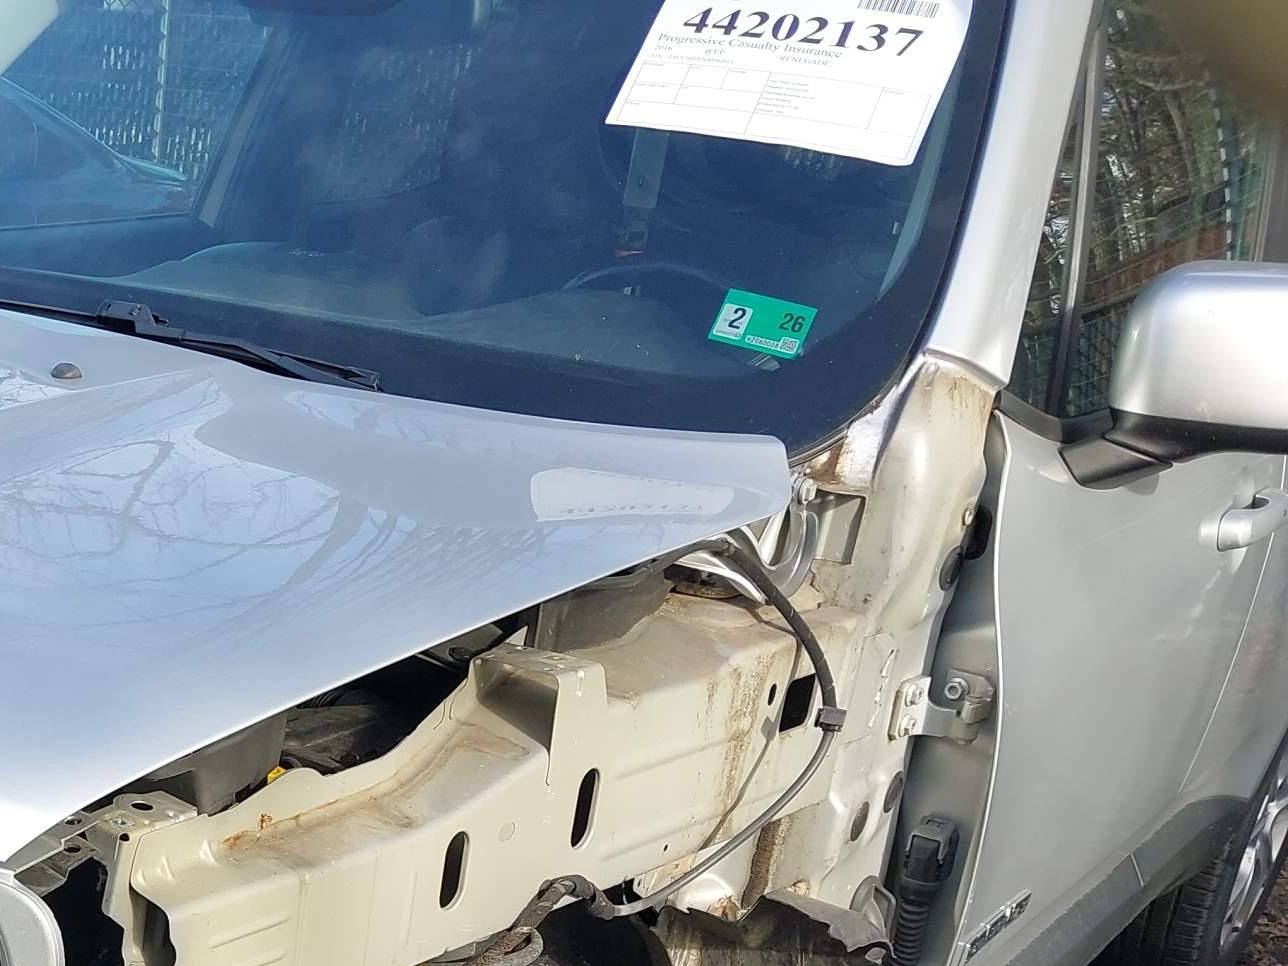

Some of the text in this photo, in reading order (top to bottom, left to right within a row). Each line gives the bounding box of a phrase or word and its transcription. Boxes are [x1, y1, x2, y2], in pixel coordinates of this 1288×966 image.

[682, 7, 925, 56] 44202137
[658, 33, 843, 59] Progressive Casualty Insurance
[779, 55, 831, 67] RENEGADE
[727, 307, 806, 333] 2 26
